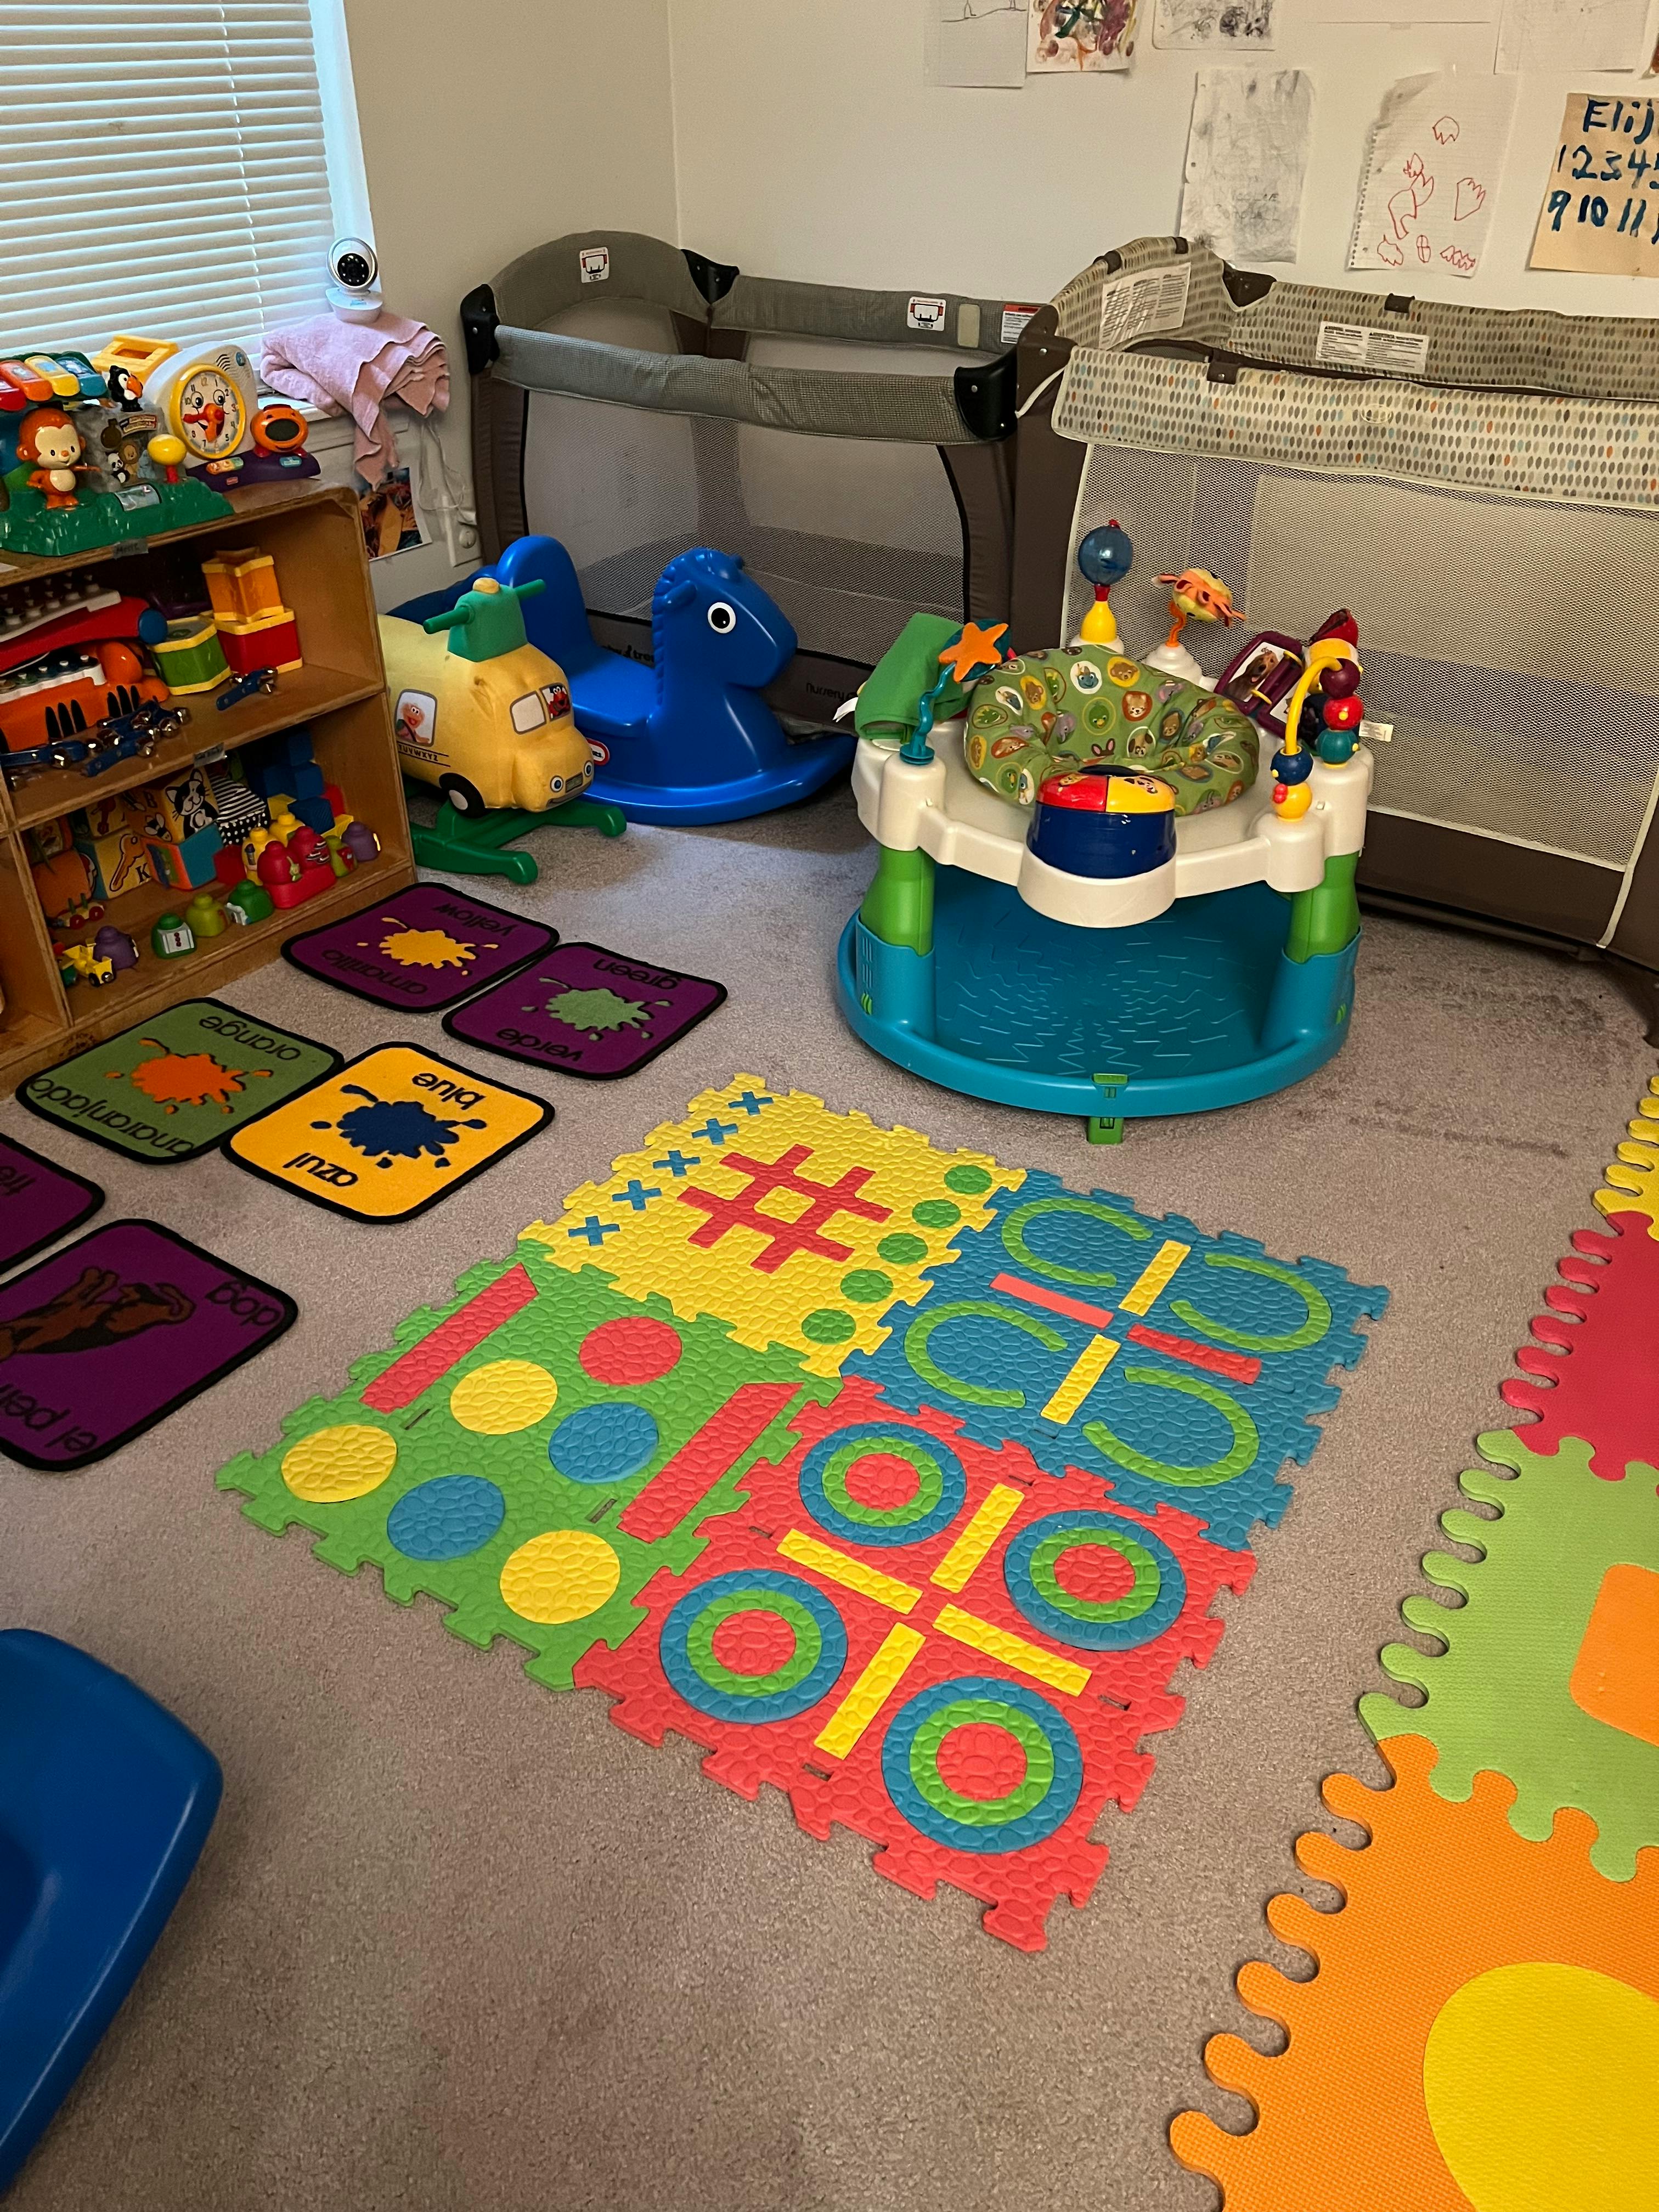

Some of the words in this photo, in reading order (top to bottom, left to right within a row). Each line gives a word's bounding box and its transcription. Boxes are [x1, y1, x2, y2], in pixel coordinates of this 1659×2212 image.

[1583, 98, 1659, 144] Elij
[224, 388, 229, 397] 2
[231, 403, 236, 412] 3
[202, 439, 206, 448] 7
[225, 433, 229, 442] 5
[398, 743, 438, 762] TUVWXYZ
[192, 810, 206, 828] C
[135, 862, 151, 884] K
[432, 902, 518, 936] yellow
[321, 949, 428, 994] amarillo
[593, 959, 681, 989] green
[199, 1016, 301, 1060] orange
[496, 1028, 583, 1062] verde
[411, 1073, 486, 1110] blue
[29, 1078, 194, 1153] anaranjado
[282, 1152, 358, 1187] azul
[204, 1279, 281, 1327] dog
[44, 1426, 98, 1452] el
